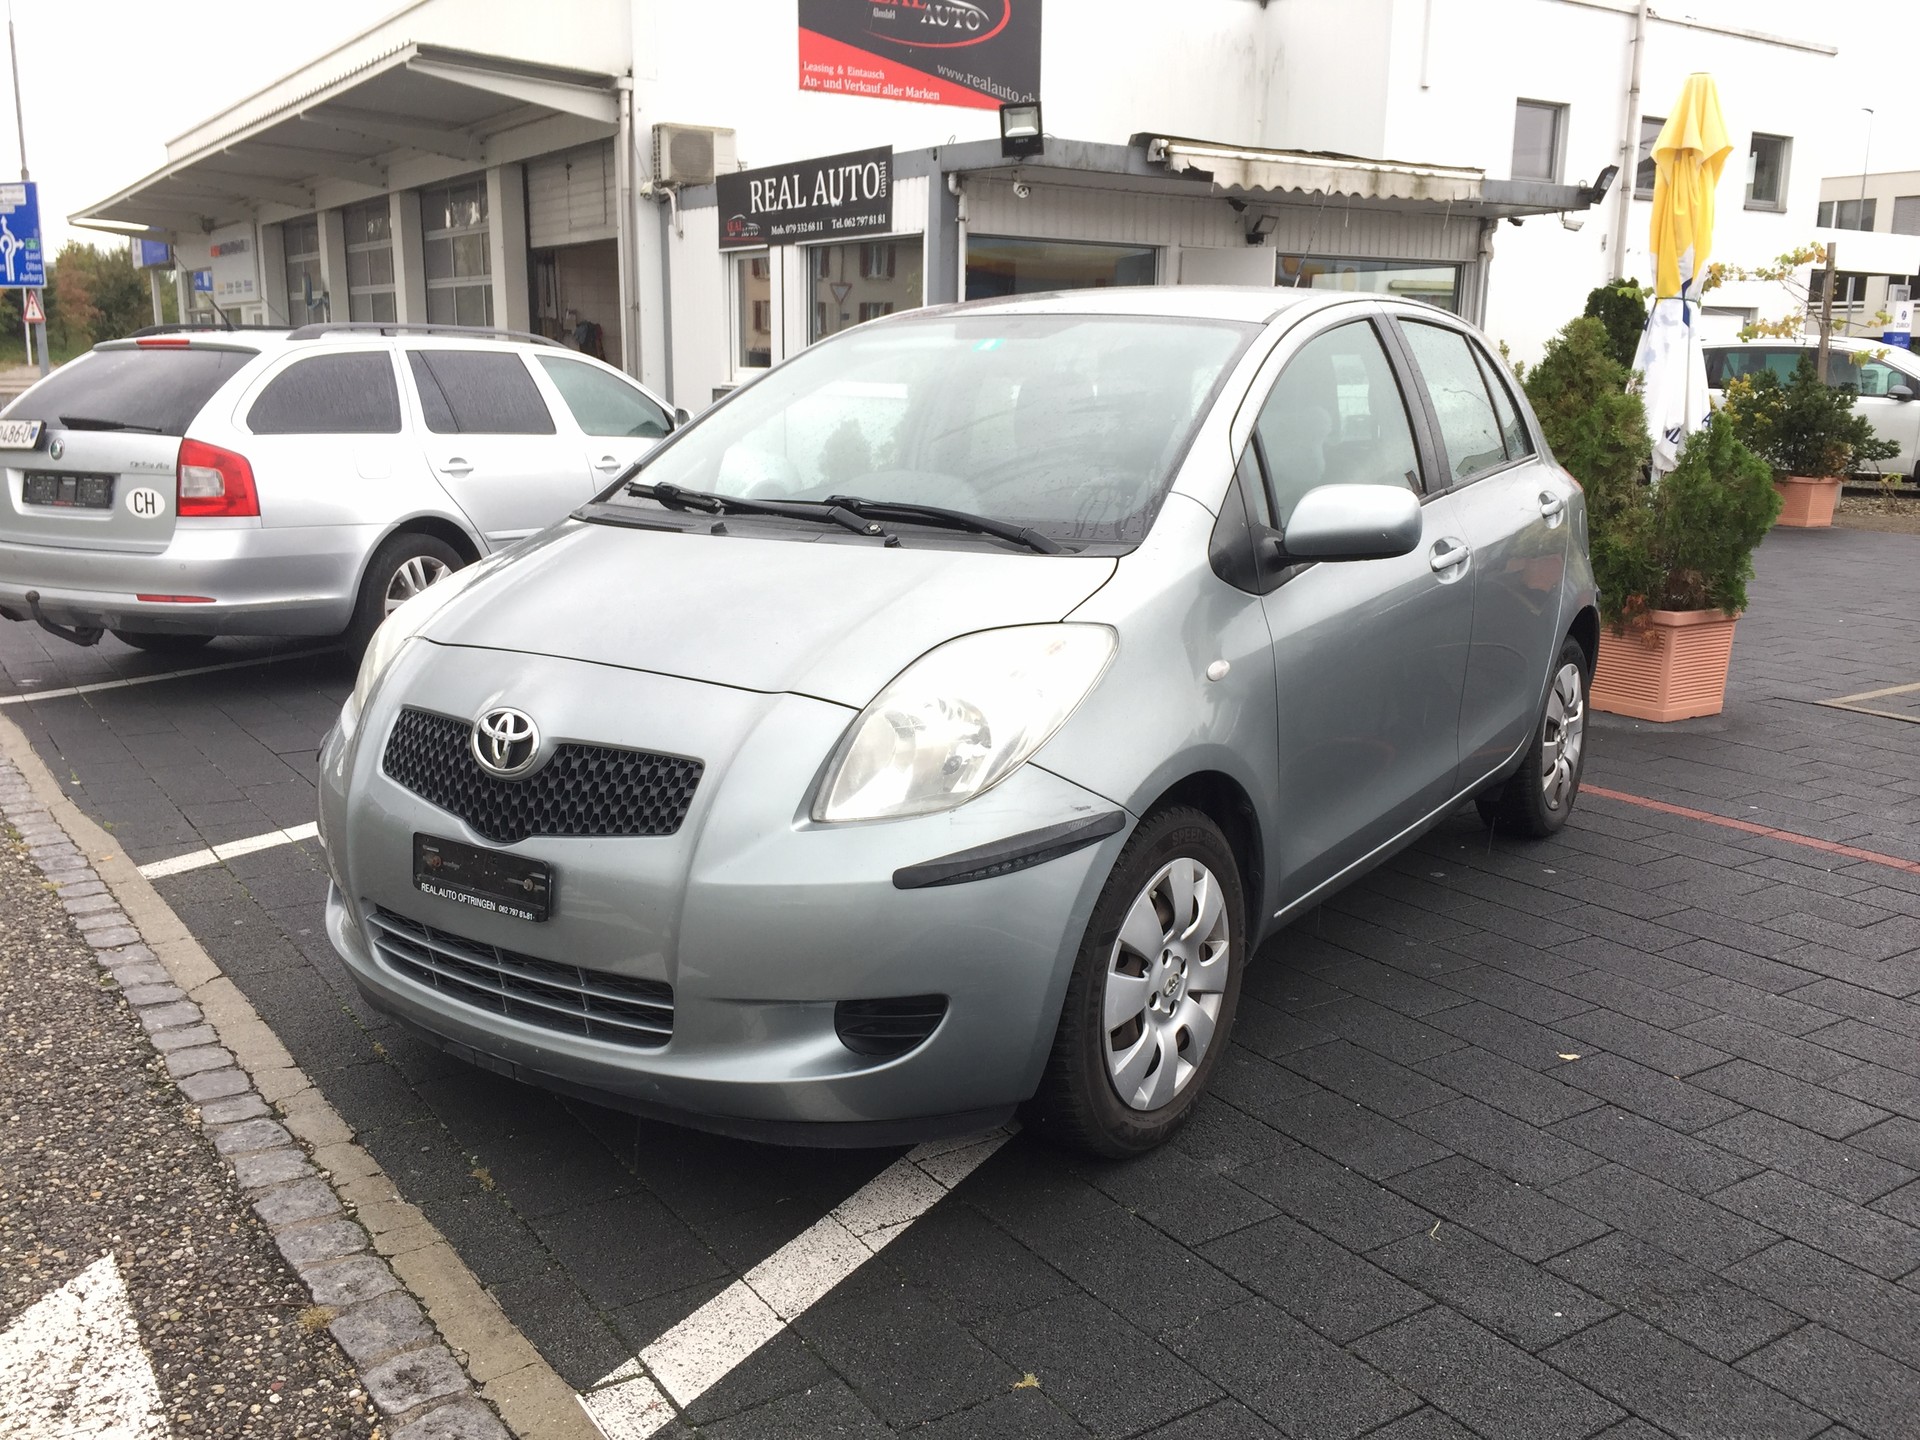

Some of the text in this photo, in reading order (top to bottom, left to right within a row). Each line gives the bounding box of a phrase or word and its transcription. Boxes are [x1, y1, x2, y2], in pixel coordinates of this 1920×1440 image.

[920, 3, 980, 31] AUTO
[803, 61, 885, 80] Leasing & Eintausch
[937, 65, 1036, 103] www.realauto.ch
[803, 74, 940, 101] An- und Verkauf aller Marken
[750, 162, 880, 214] REAL AUTO
[879, 161, 887, 198] GmbH
[771, 221, 823, 236] Mob. 079 332 68 11
[832, 213, 886, 229] Tel. 062 797 81 81
[20, 272, 43, 284] Aarburg
[134, 491, 156, 515] CH
[421, 882, 437, 895] REAL
[438, 888, 457, 901] AUTO
[458, 893, 496, 911] OFTRINGEN
